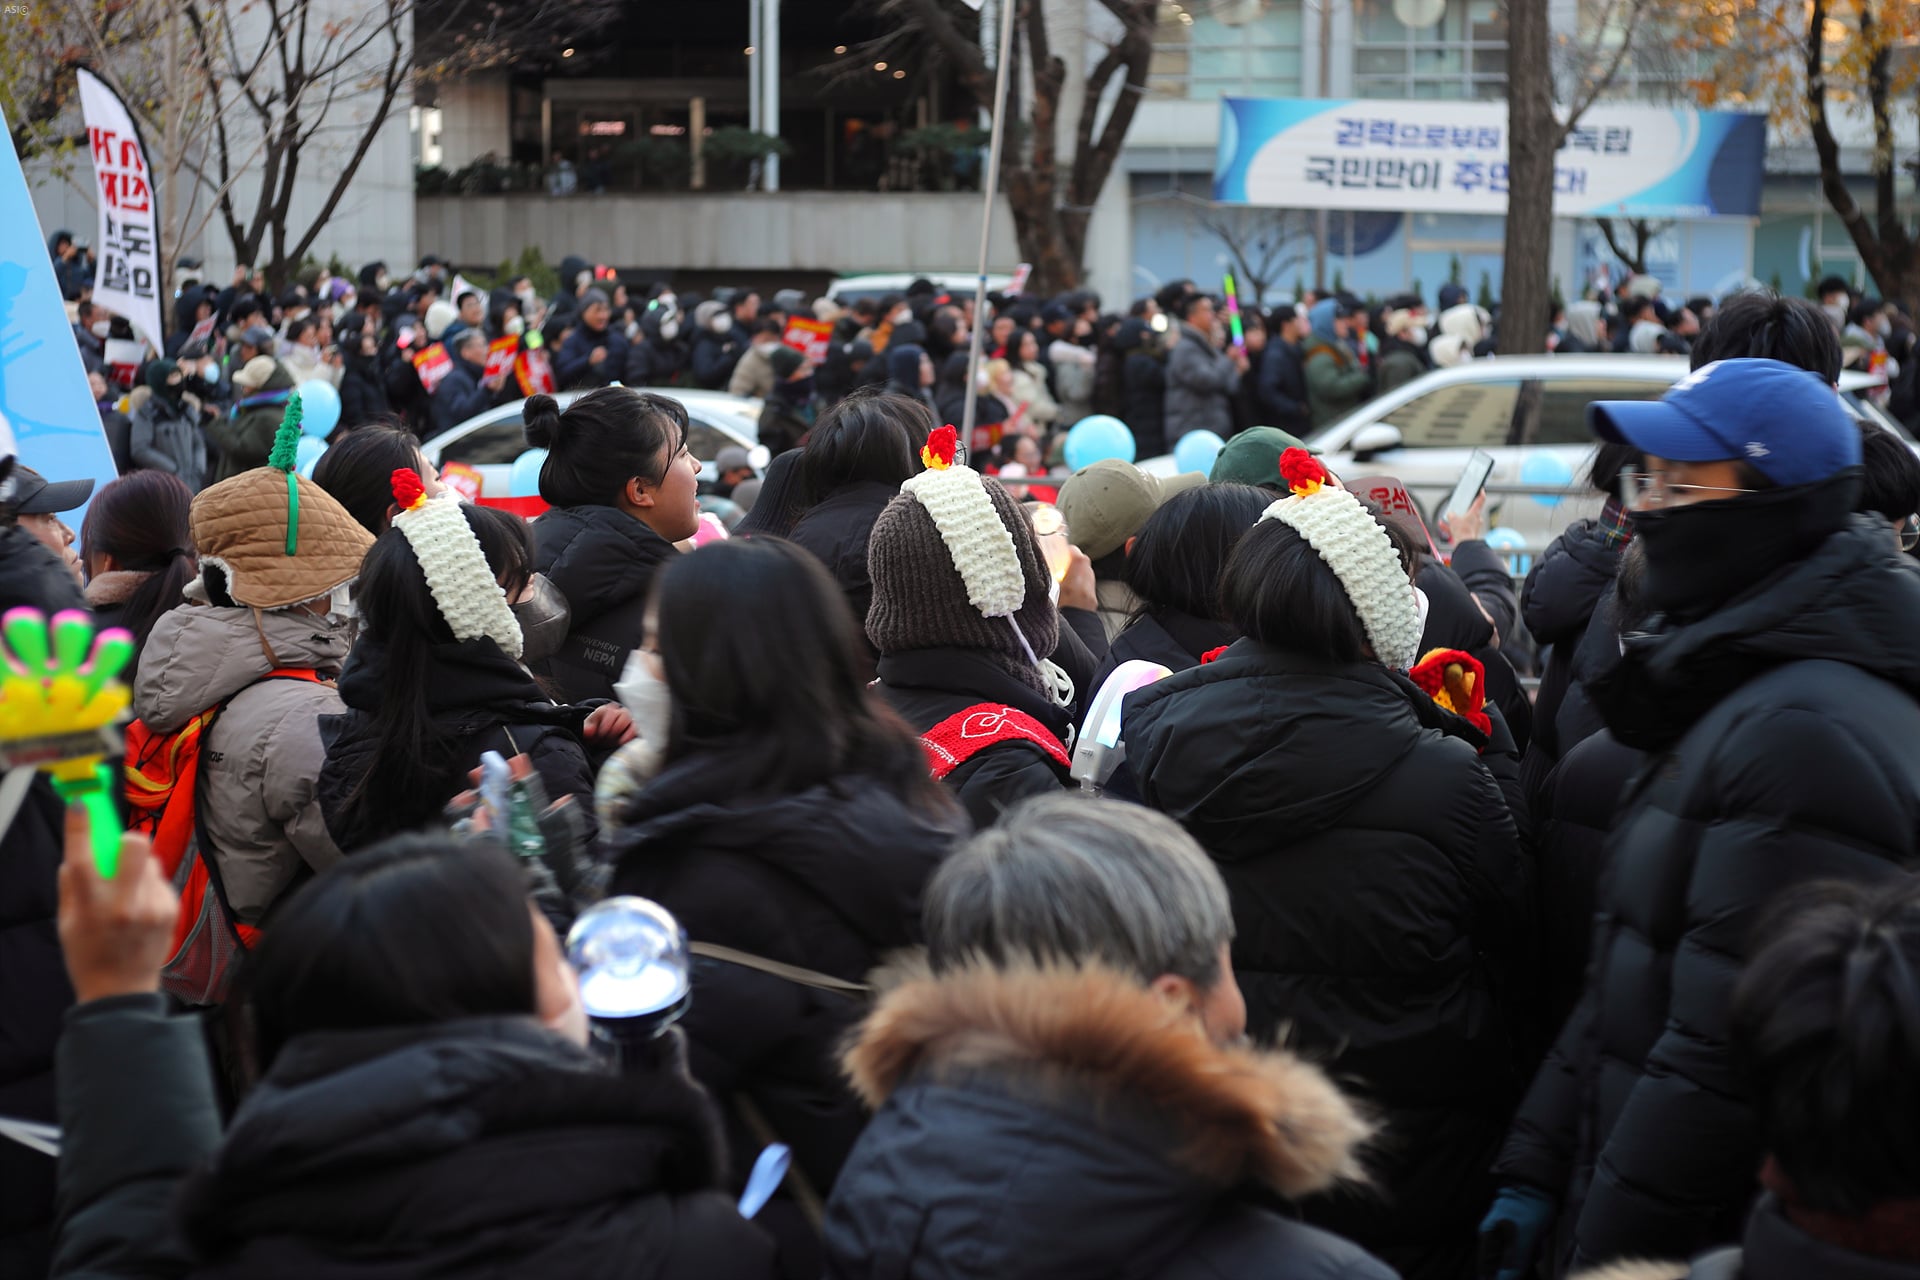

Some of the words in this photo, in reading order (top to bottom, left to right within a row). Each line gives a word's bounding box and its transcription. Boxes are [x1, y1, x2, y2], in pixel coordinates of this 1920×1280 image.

[1304, 155, 1442, 190] 국민만이
[576, 634, 621, 653] MOVEMENT
[583, 647, 616, 667] NEPA
